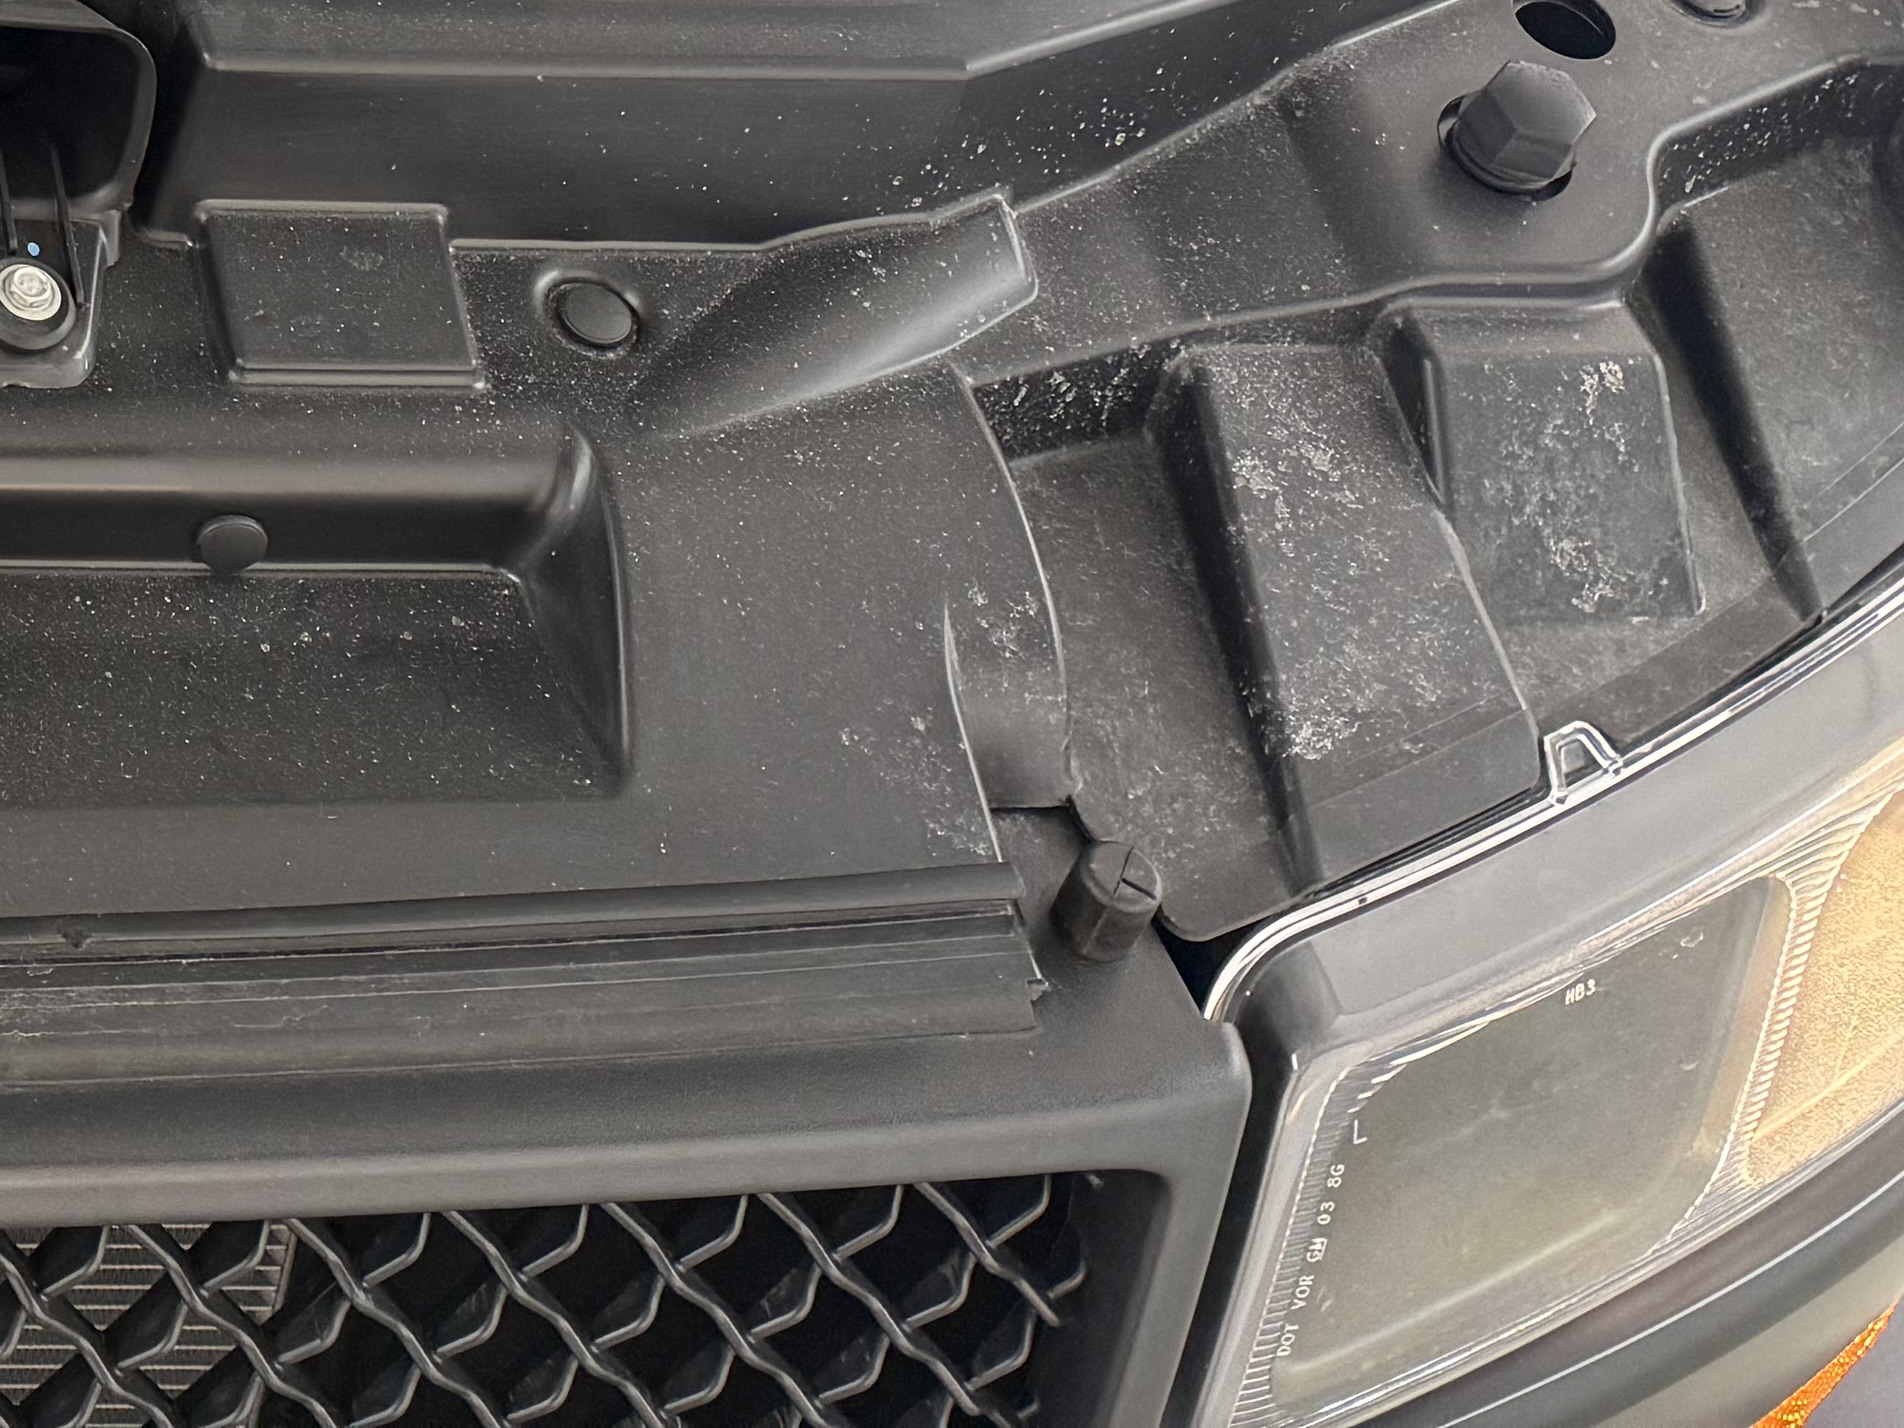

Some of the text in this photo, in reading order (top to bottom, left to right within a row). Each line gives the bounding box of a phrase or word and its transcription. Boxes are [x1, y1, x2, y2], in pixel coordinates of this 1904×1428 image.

[1565, 978, 1596, 1005] HB3
[1353, 1119, 1368, 1145] L
[1276, 1323, 1300, 1357] DOT
[1290, 1274, 1315, 1310] VOR
[1317, 1201, 1336, 1225] 03
